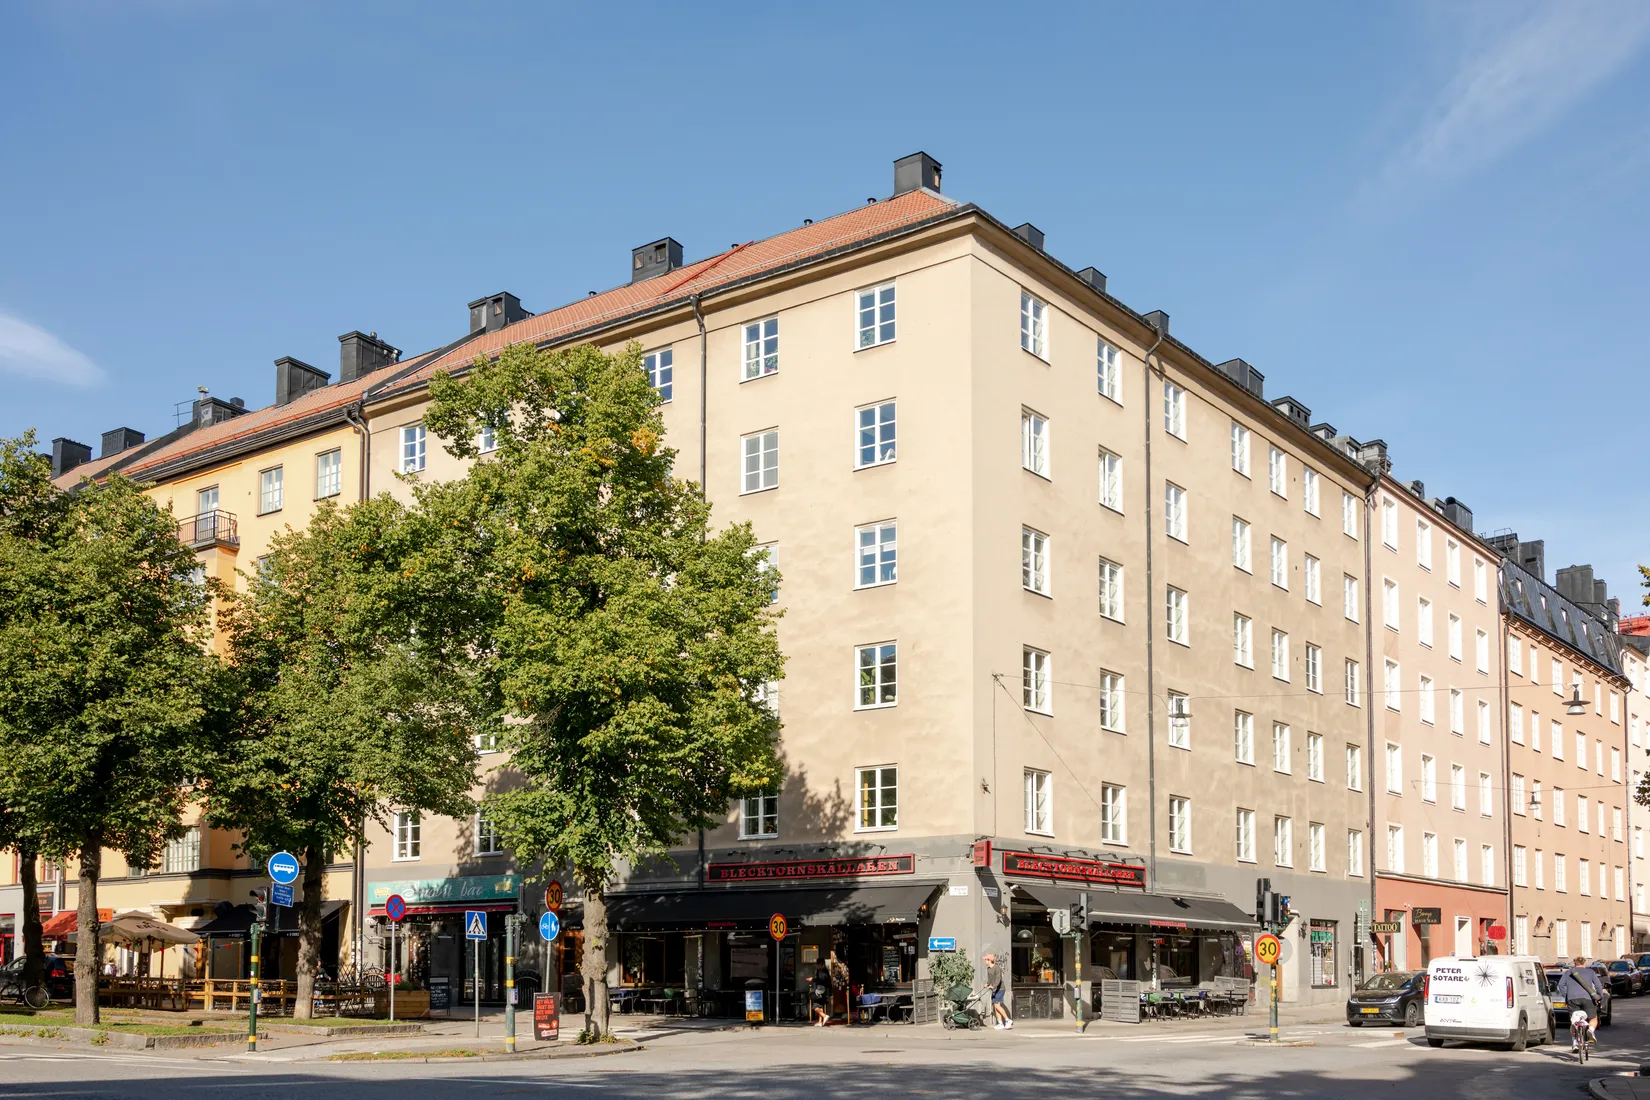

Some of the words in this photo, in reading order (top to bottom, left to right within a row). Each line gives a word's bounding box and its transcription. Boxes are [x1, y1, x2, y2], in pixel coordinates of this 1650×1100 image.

[720, 861, 899, 878] BLECKTORNSKÄLLAREN
[549, 888, 560, 904] 30
[773, 920, 785, 935] 30
[1372, 922, 1398, 933] TATTOO
[1259, 942, 1277, 957] 30
